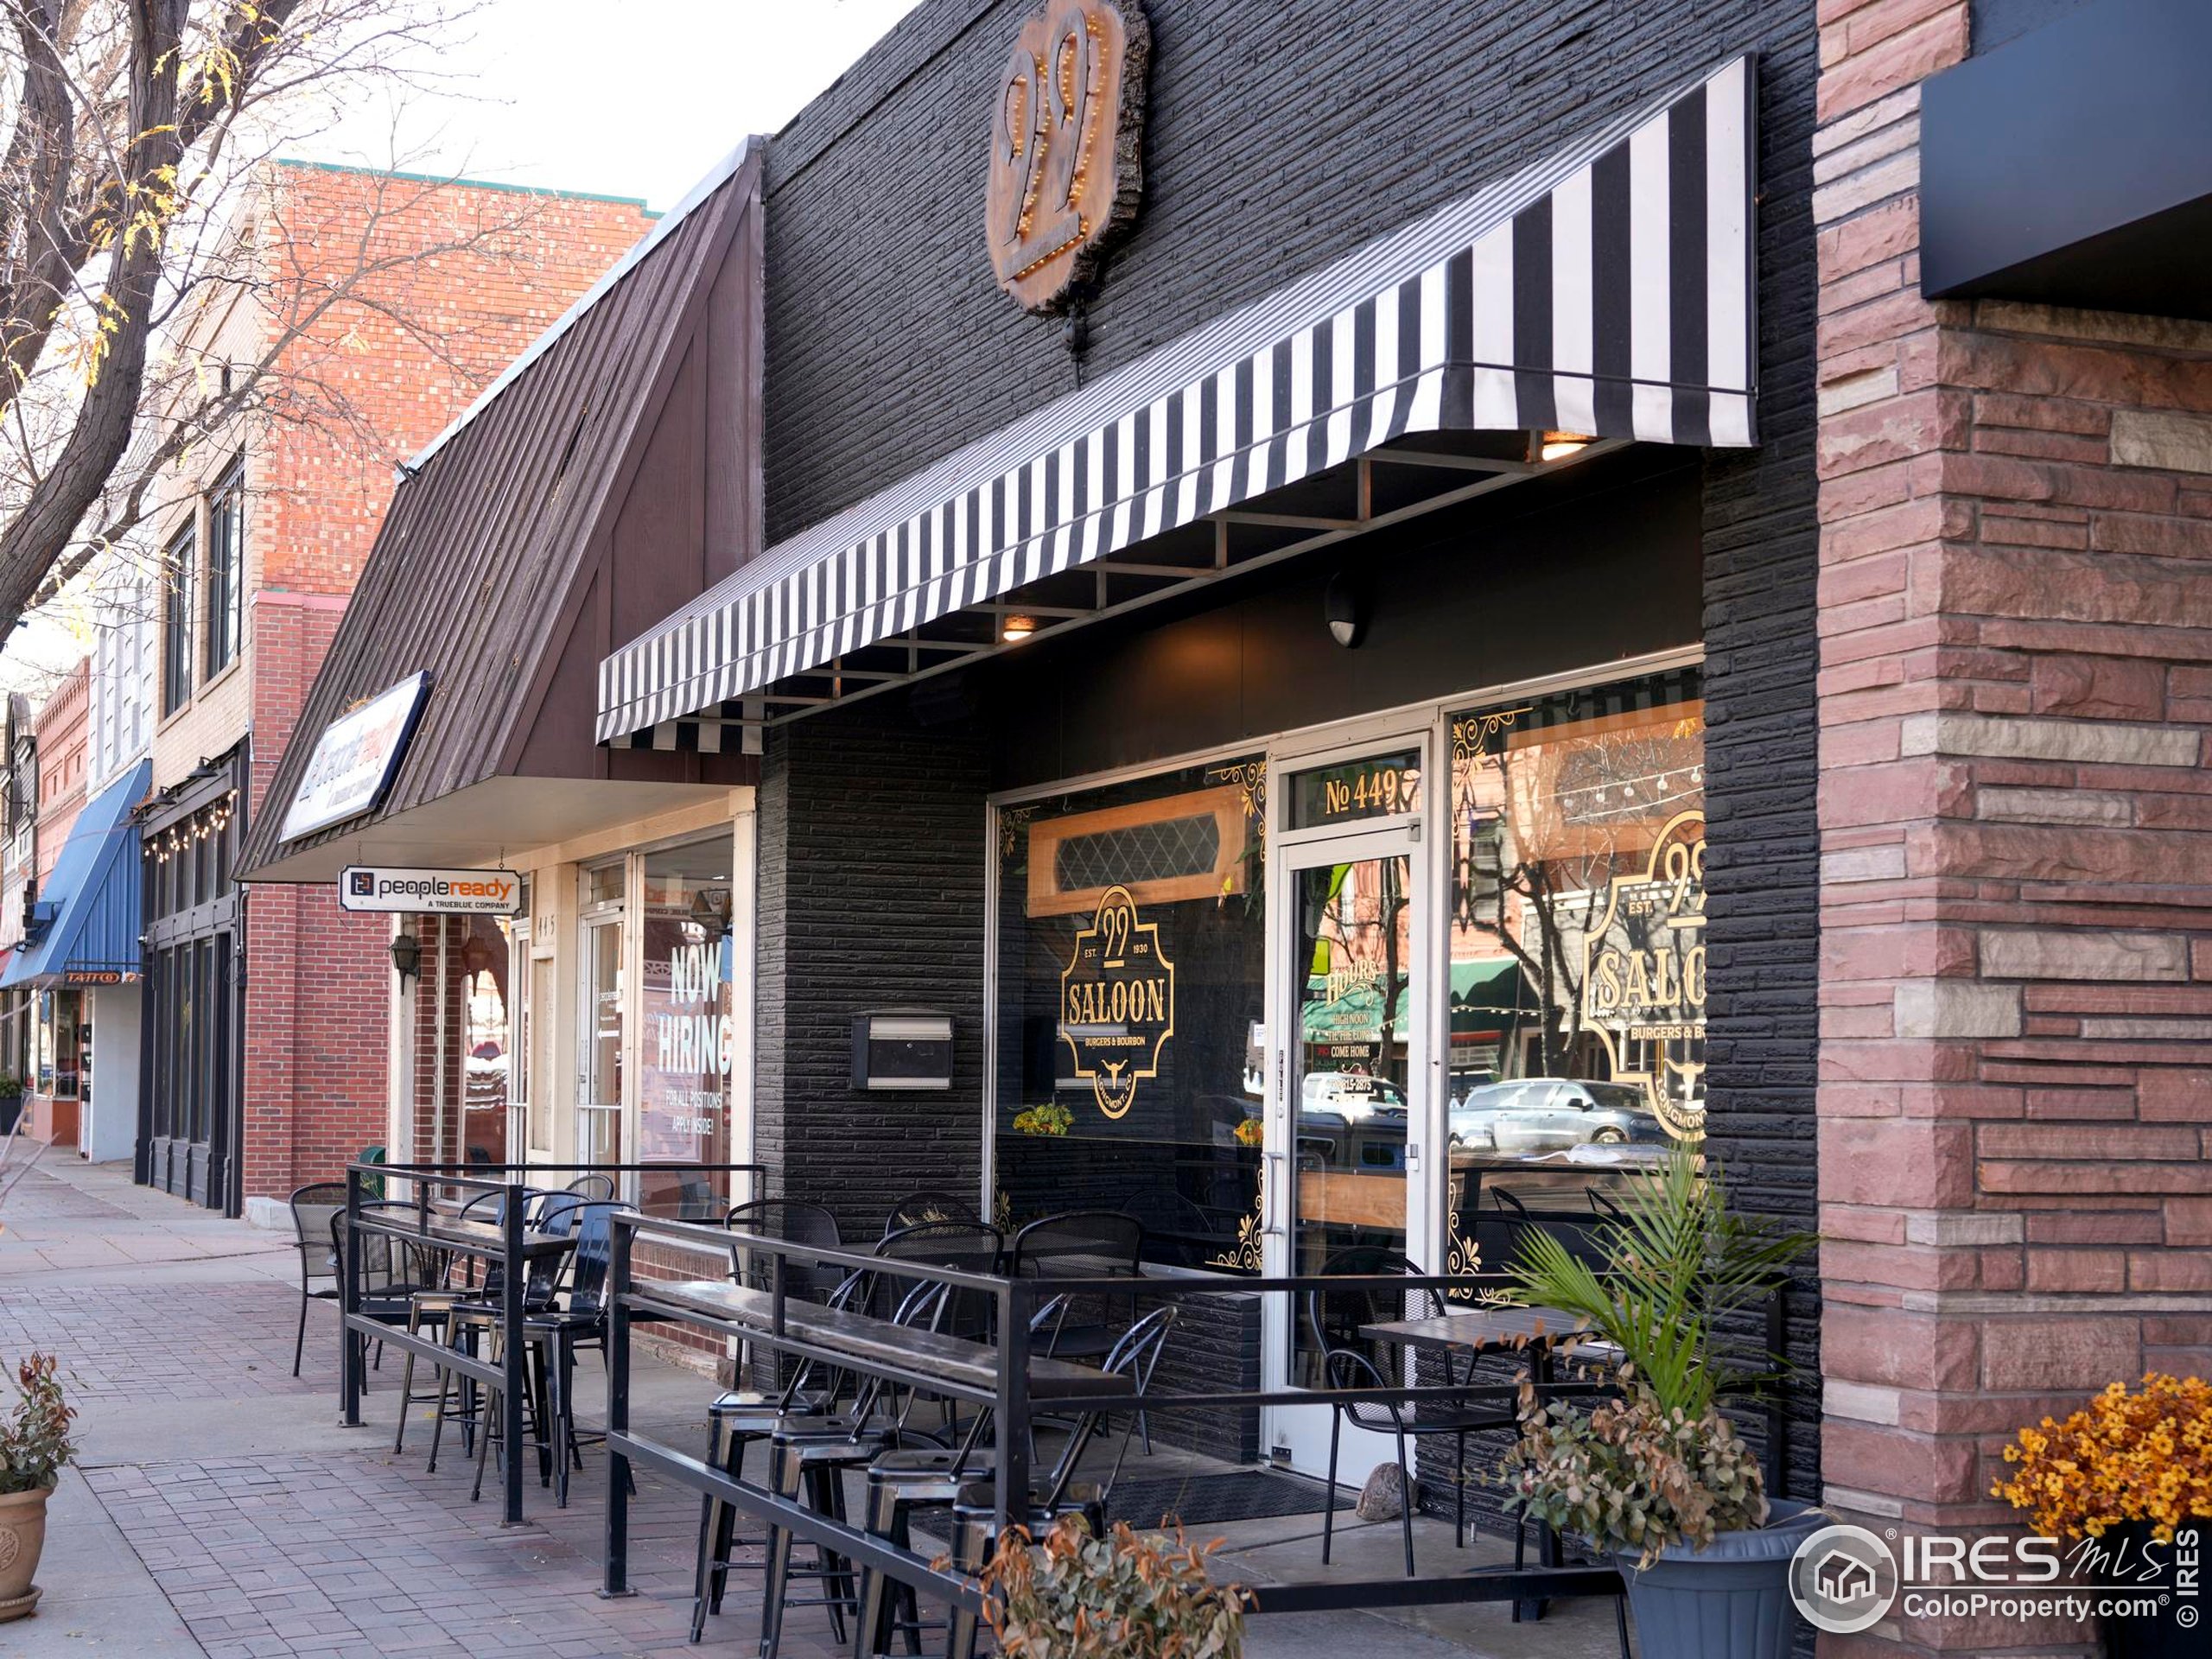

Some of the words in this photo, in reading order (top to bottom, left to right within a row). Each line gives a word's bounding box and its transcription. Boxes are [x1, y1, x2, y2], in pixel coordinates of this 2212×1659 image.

[1354, 769, 1397, 809] 449
[379, 876, 512, 900] peopleready
[475, 901, 510, 910] COMPANY
[1629, 900, 1653, 914] EST.
[1084, 949, 1096, 958] EST.
[1133, 944, 1148, 955] 1930
[69, 972, 120, 983] TATTOO
[671, 942, 721, 1006] NOW
[1326, 959, 1380, 1009] HOURS
[1069, 978, 1166, 1025] SALOON
[1333, 1014, 1349, 1025] HIGH
[1350, 1013, 1370, 1025] NOON
[1630, 1026, 1681, 1039] BURGERS
[1683, 1026, 1692, 1039] &
[658, 1014, 733, 1075] HIRING
[1085, 1037, 1110, 1046] BURGERS
[1111, 1037, 1116, 1046] &
[1116, 1037, 1145, 1046] BOURBON
[1331, 1046, 1349, 1058] COME
[1350, 1045, 1370, 1057] HOME
[665, 1089, 677, 1106] FOR
[678, 1090, 690, 1107] ALL
[690, 1091, 722, 1109] POSITIONS
[671, 1116, 690, 1133] APPLY
[691, 1118, 714, 1136] INSIDE!
